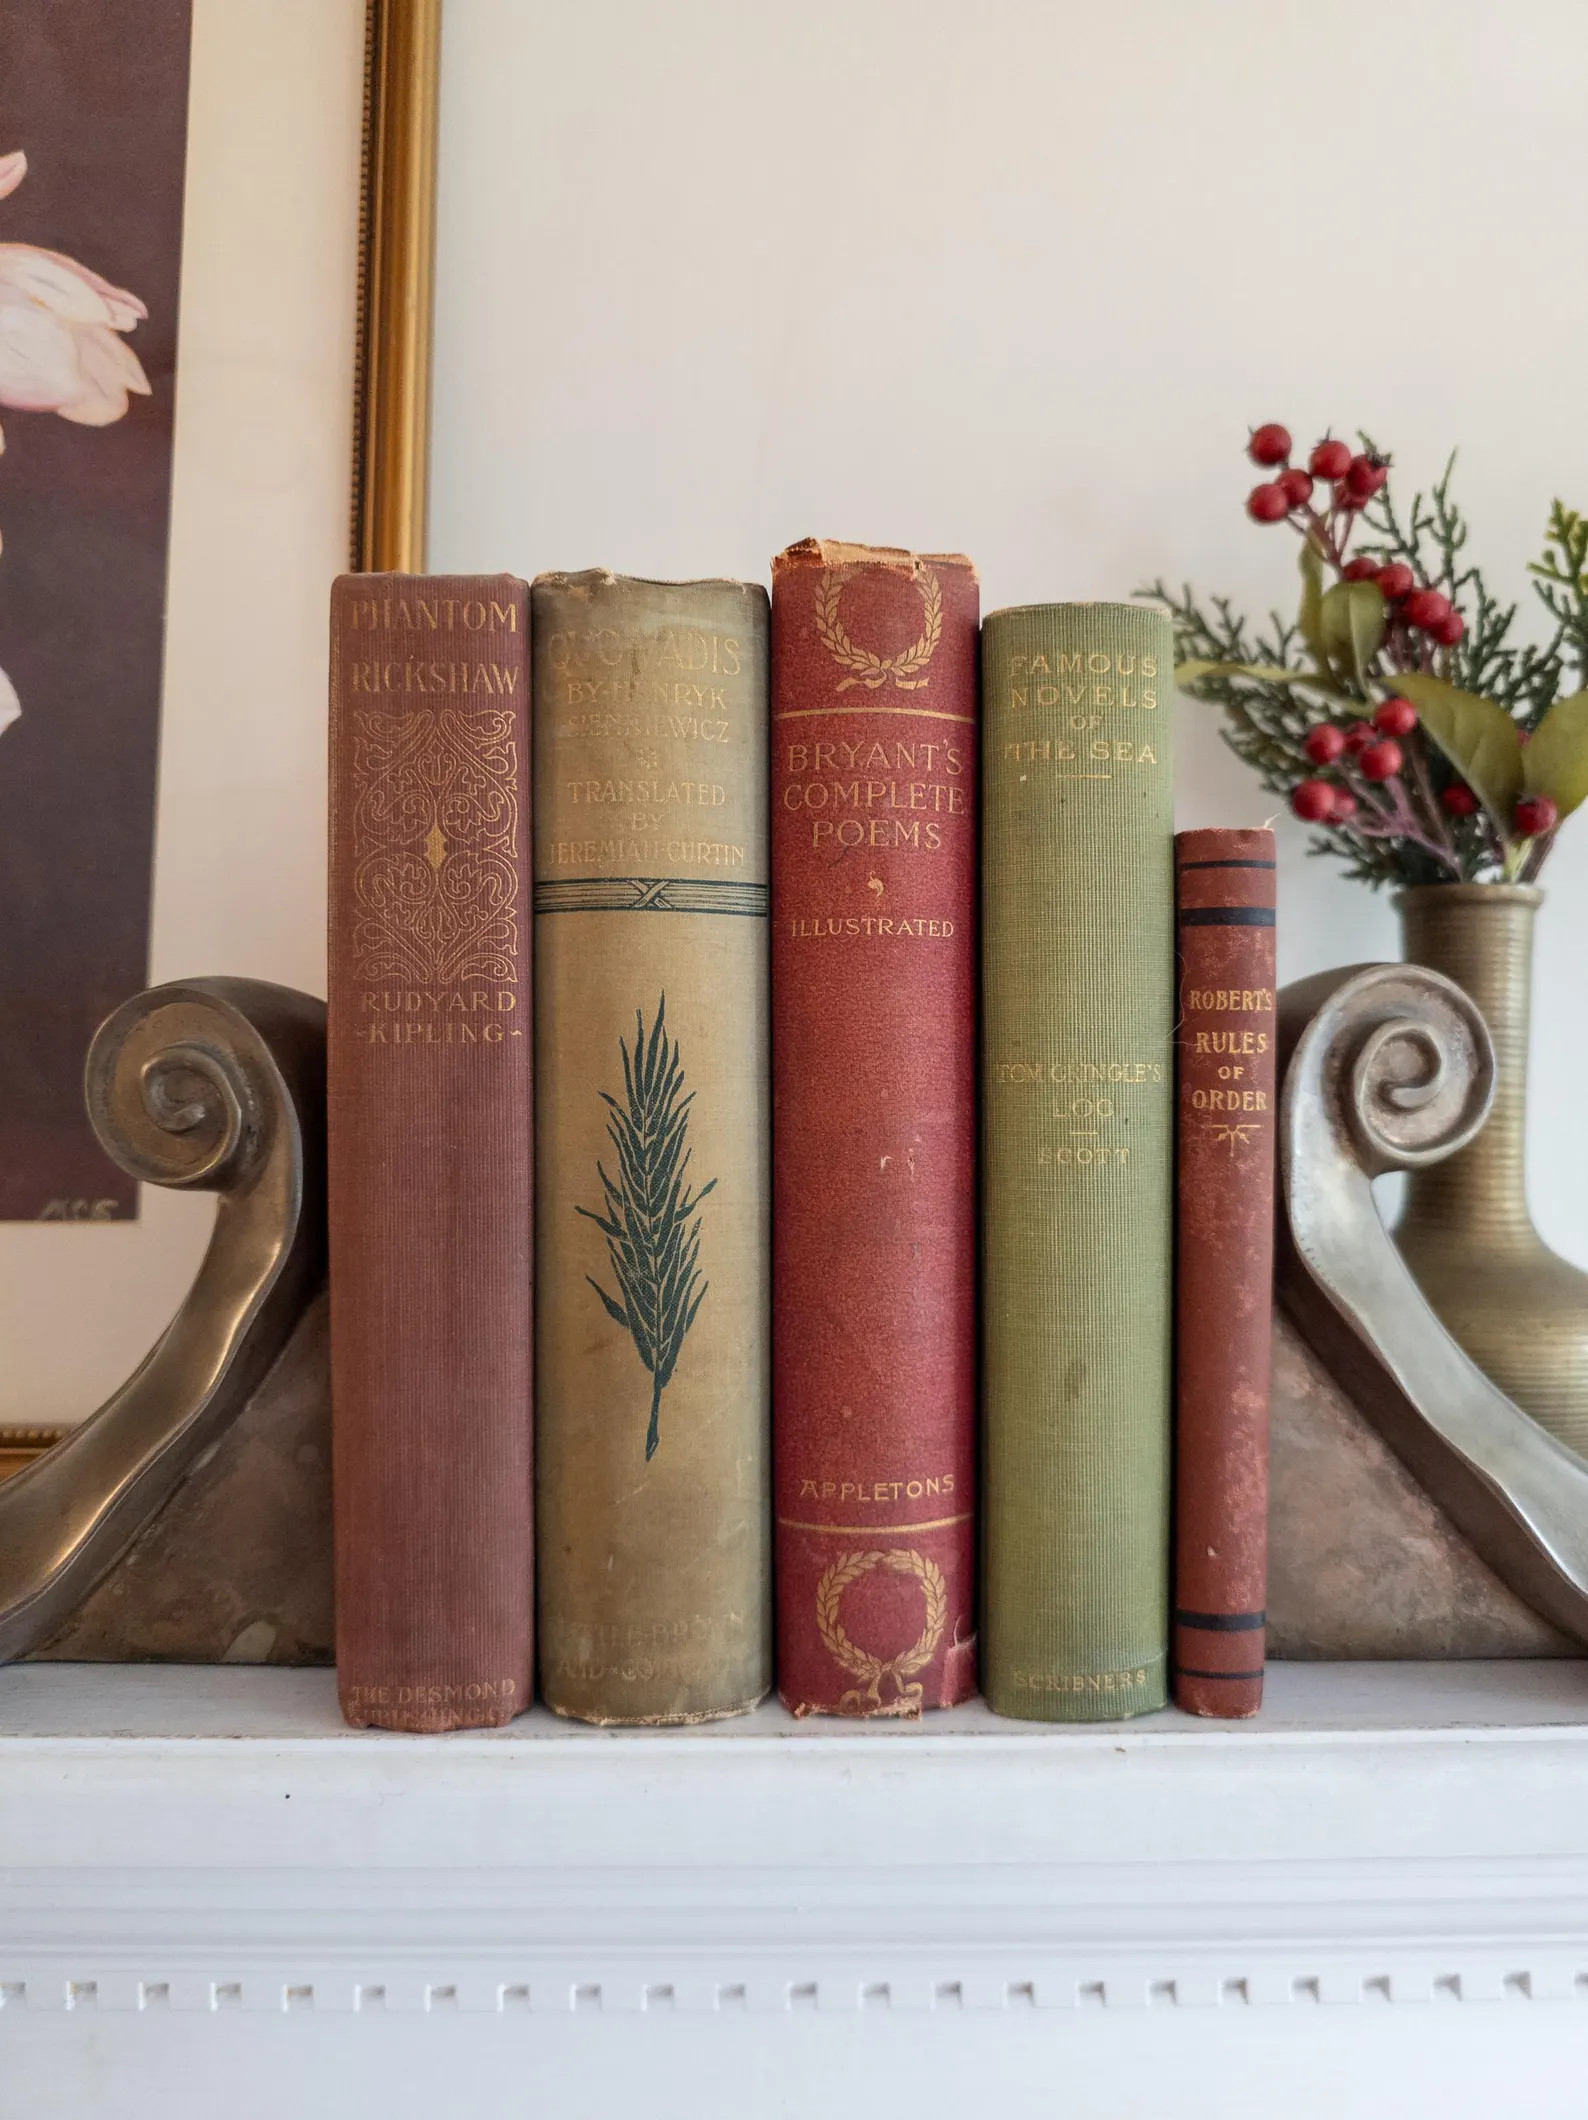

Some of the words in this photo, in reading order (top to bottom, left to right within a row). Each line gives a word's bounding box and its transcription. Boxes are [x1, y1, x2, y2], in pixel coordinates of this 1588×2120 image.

[352, 599, 519, 633] PHANTOM
[352, 660, 520, 695] RICKSHAW
[1010, 653, 1158, 678] FAMOUS
[1010, 685, 1158, 709] NOVELS
[1070, 714, 1104, 730] OF
[787, 739, 963, 776] BRYANT'S
[1004, 739, 1076, 762] THE
[1090, 740, 1158, 764] SEA
[567, 779, 726, 806] TRANSLATED
[783, 781, 965, 815] COMPLETE
[630, 811, 665, 831] BY
[812, 819, 942, 849] POEMS
[791, 917, 955, 939] ILLUSTRATED
[361, 990, 517, 1013] RUDYARD
[1189, 988, 1273, 1013] ROBERT'S
[368, 1022, 504, 1044] KIPLING
[1195, 1031, 1268, 1055] RULES
[995, 1063, 1044, 1084] TOM
[1216, 1065, 1246, 1081] OF
[1191, 1088, 1269, 1112] ORDER
[1038, 1147, 1131, 1165] SCOTT
[799, 1473, 956, 1502] APPLETONS
[351, 1684, 390, 1705] THE
[398, 1677, 518, 1705] DESMOND
[1014, 1667, 1147, 1693] SCRIBNERS
